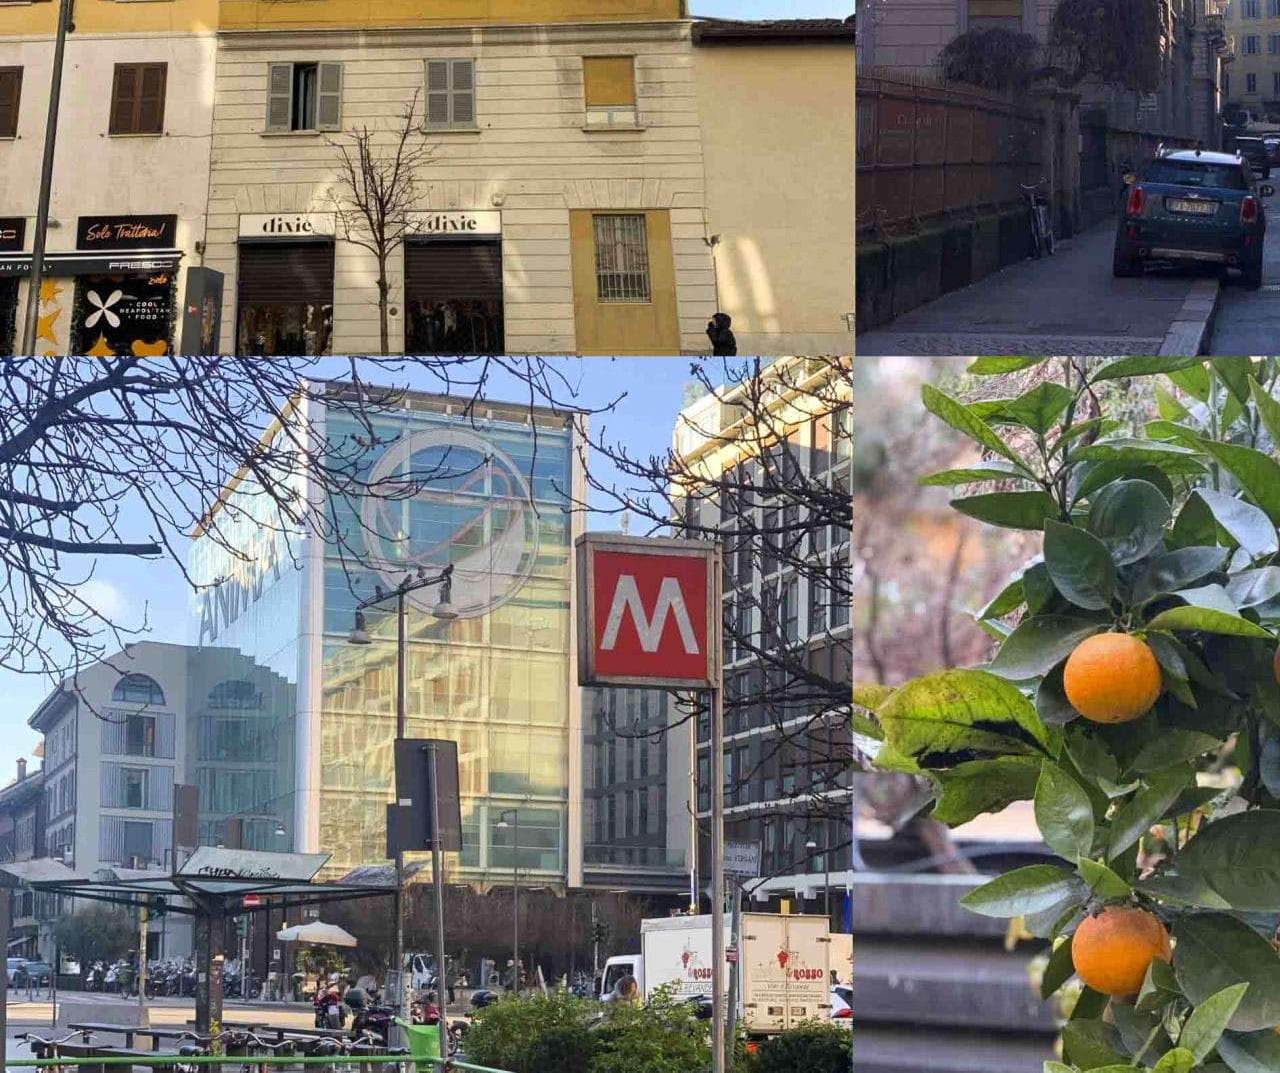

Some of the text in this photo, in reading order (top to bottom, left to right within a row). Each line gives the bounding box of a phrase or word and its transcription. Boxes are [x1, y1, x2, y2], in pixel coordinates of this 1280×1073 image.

[262, 217, 312, 233] dixie
[428, 215, 477, 231] dixie
[86, 223, 112, 241] Solo
[108, 260, 173, 270] FRESCO
[599, 573, 701, 656] M
[694, 968, 714, 980] ROSS
[793, 968, 824, 981] ROSSO
